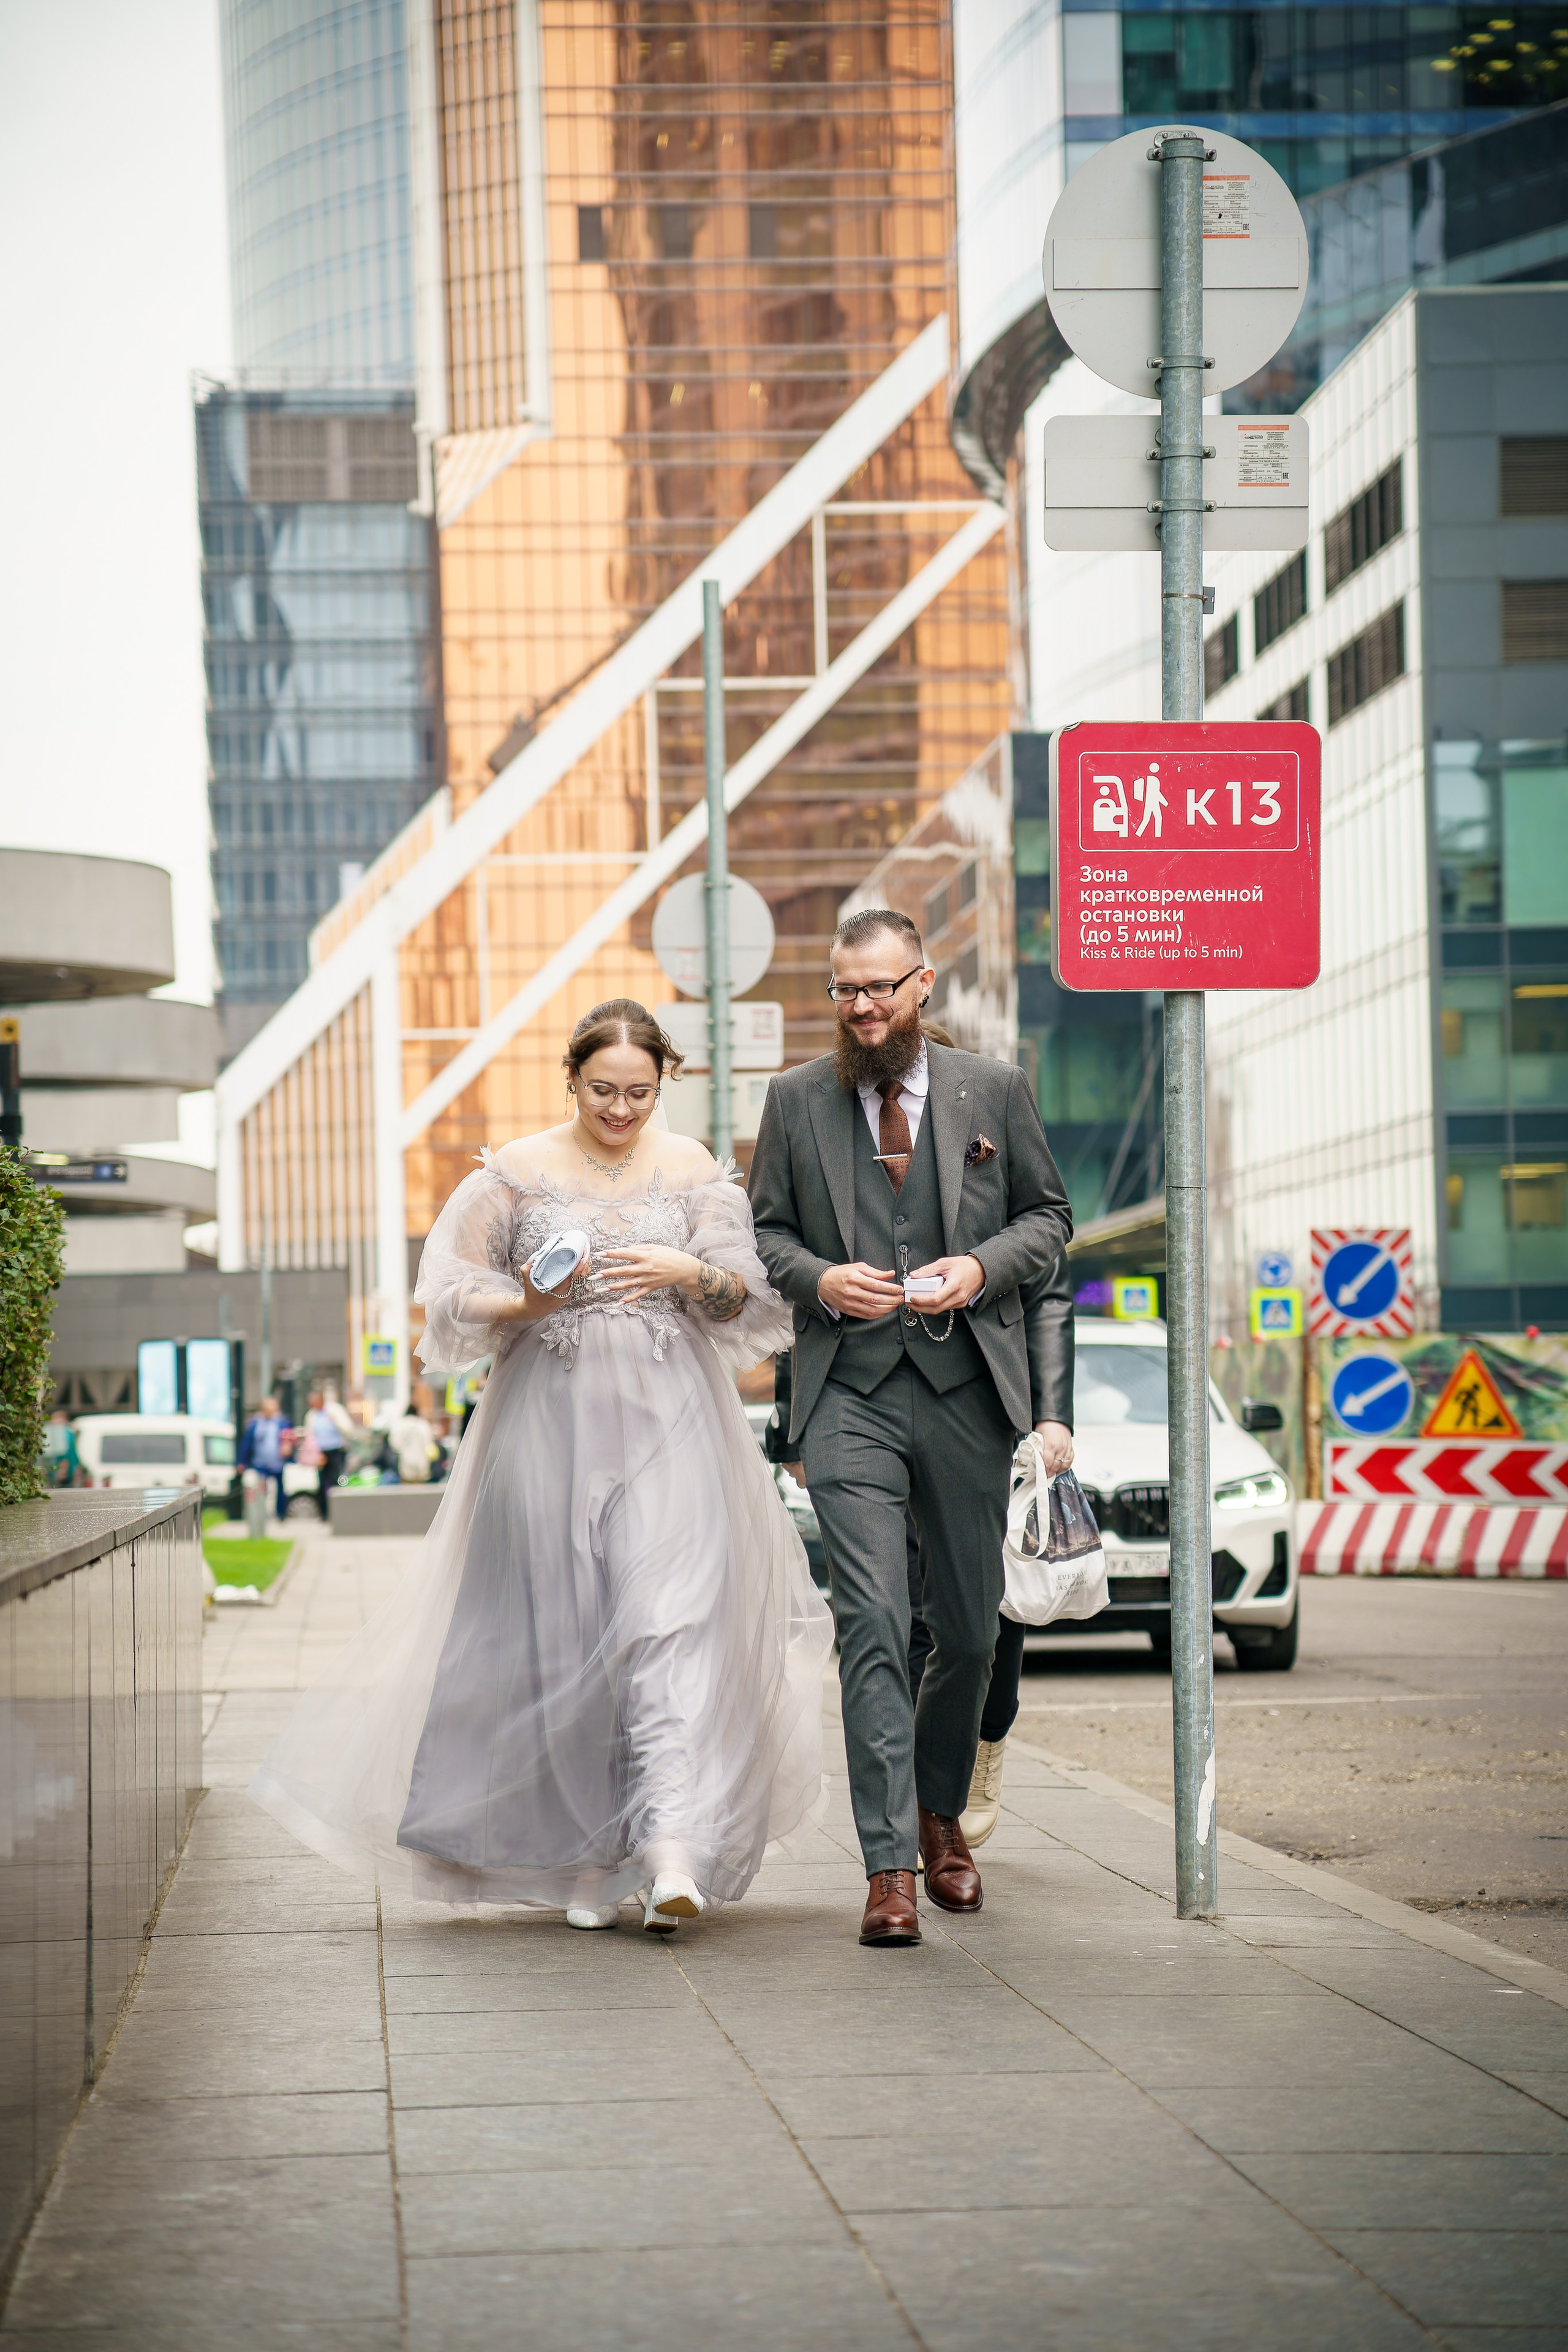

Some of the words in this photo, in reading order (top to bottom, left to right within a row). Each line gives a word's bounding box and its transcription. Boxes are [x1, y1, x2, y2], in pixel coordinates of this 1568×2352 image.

[1079, 865, 1128, 883] Зона
[1080, 884, 1264, 907] кратковременной
[1080, 910, 1184, 923] остановки
[1080, 924, 1112, 946] (до
[1117, 925, 1129, 943] 5
[1134, 923, 1183, 944] мин)
[1080, 946, 1107, 959] Kiss
[1110, 946, 1121, 959] &
[1125, 946, 1156, 959] Ride
[1159, 945, 1181, 961] (up
[1183, 946, 1198, 959] to
[1200, 946, 1210, 959] 5
[1213, 944, 1243, 960] min)
